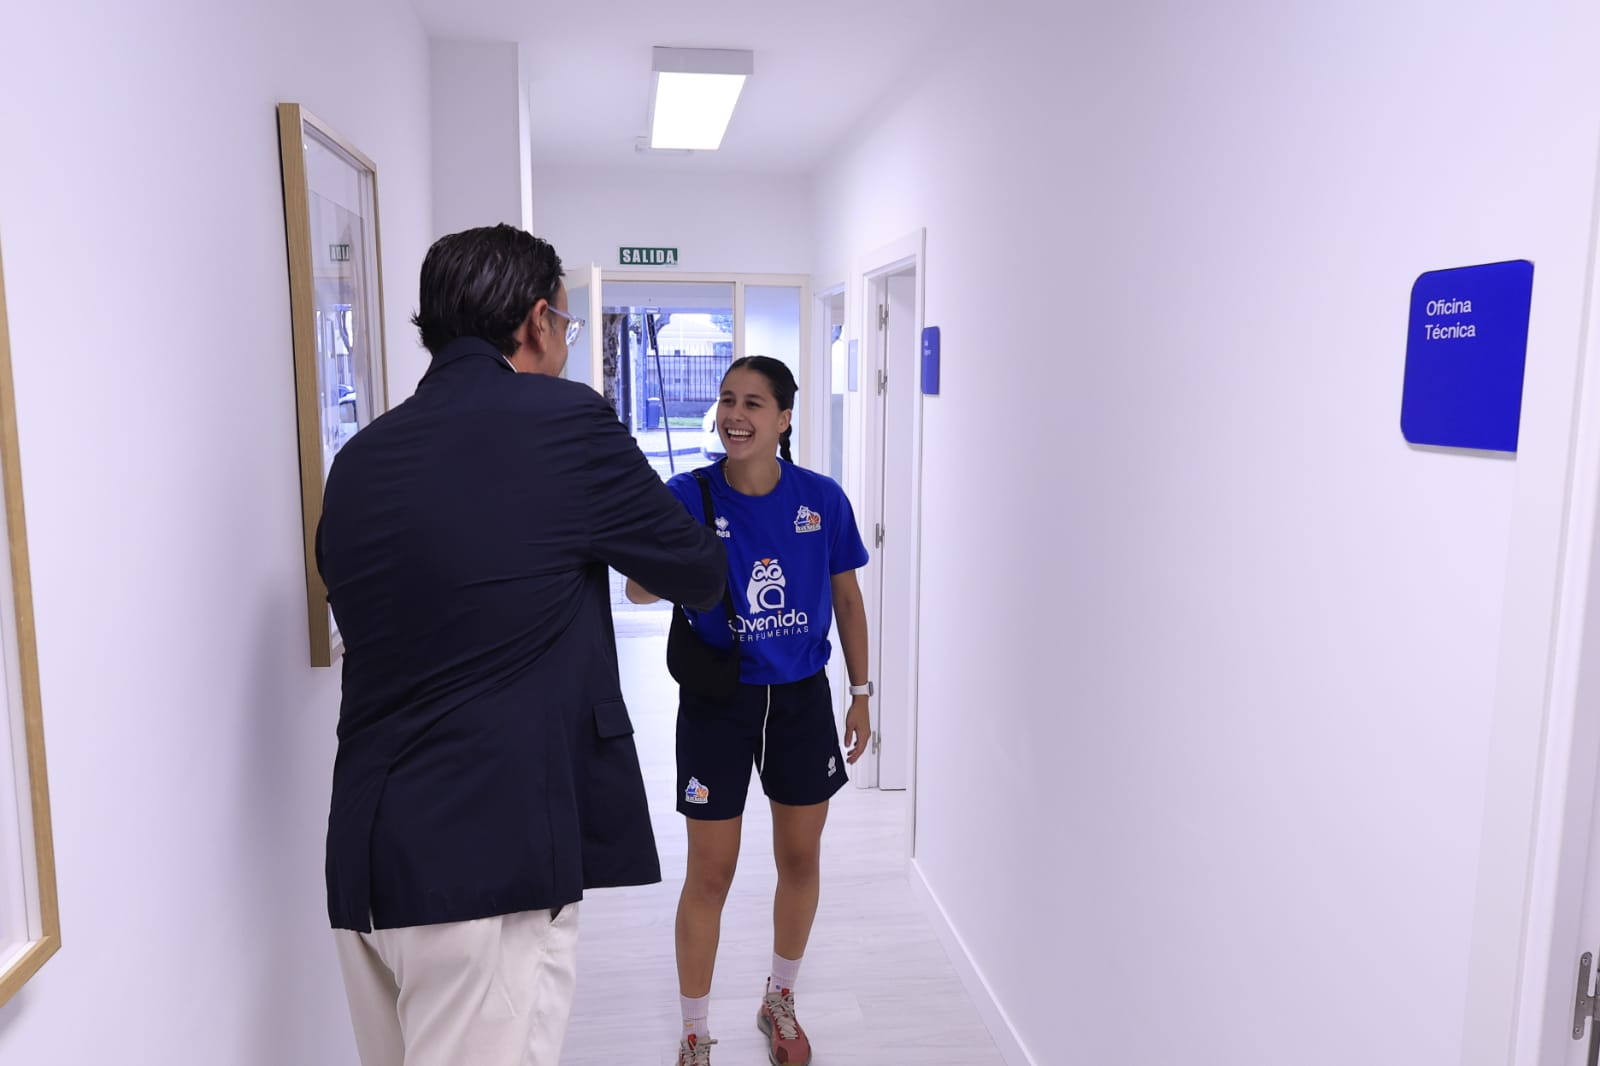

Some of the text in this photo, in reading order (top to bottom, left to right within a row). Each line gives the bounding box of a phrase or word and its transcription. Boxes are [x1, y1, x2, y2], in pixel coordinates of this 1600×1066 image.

[622, 249, 675, 263] SALIDA
[1426, 298, 1472, 316] Oficina
[1425, 322, 1476, 340] Técnica
[732, 626, 809, 642] ERFUMERÍAS
